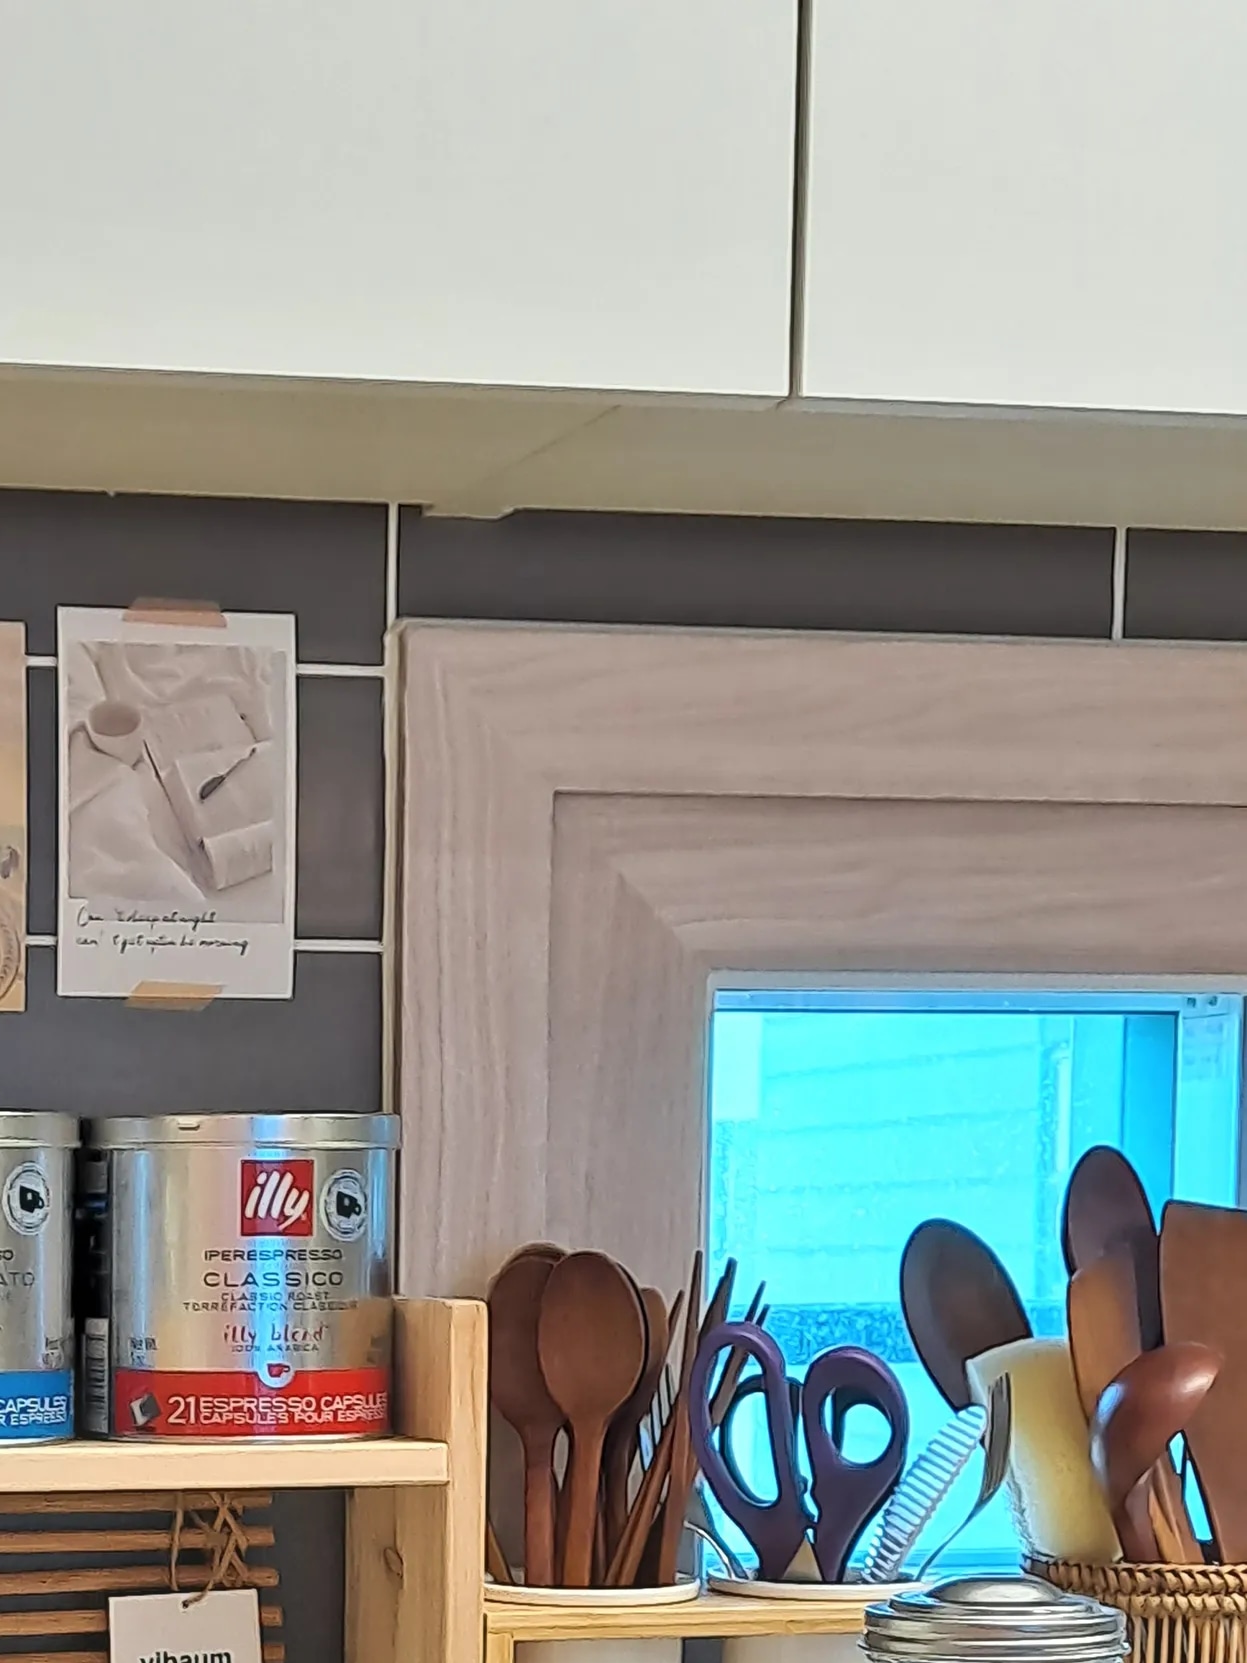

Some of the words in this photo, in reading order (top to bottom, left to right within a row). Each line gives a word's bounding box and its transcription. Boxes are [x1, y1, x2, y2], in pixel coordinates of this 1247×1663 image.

[244, 1170, 311, 1232] illy
[204, 1249, 343, 1261] IPERESPRESSO
[203, 1271, 344, 1287] CLASSICO
[224, 1324, 257, 1346] illy
[167, 1396, 196, 1425] 21
[199, 1396, 317, 1413] ESPRESSO
[199, 1411, 289, 1425] CAPSULES
[293, 1410, 333, 1424] POUR
